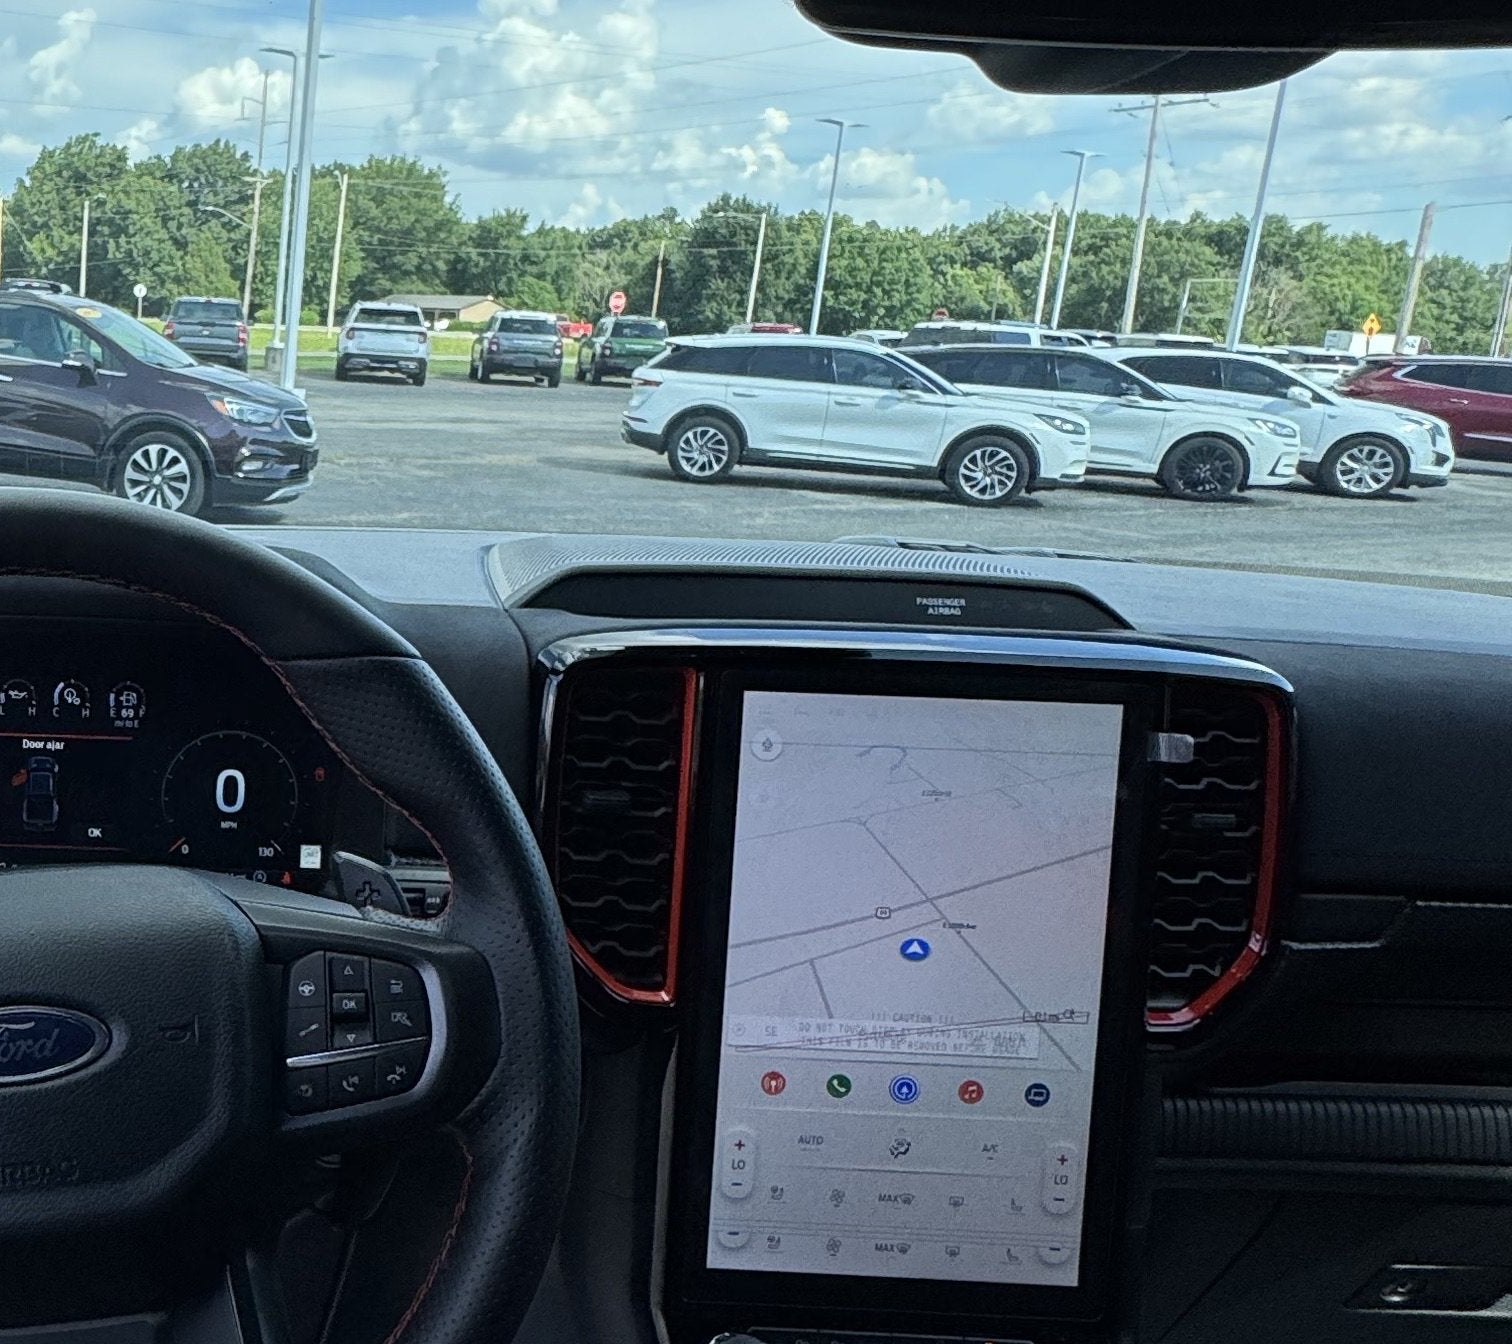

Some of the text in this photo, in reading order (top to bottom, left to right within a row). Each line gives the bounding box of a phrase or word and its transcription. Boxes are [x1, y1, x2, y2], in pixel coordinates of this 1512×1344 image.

[916, 597, 967, 607] PASSENGER
[927, 606, 962, 616] AIRBAG
[120, 709, 134, 718] 69
[22, 739, 65, 752] Door ajar
[215, 768, 246, 814] 0
[220, 821, 238, 830] MPH
[88, 828, 102, 838] OK
[258, 846, 275, 858] 130
[342, 1000, 357, 1010] OK
[797, 1135, 999, 1154] AUTO A/C
[731, 1159, 746, 1170] LO
[1054, 1174, 1069, 1186] LO
[878, 1194, 899, 1204] MAX
[875, 1243, 894, 1254] MAX
